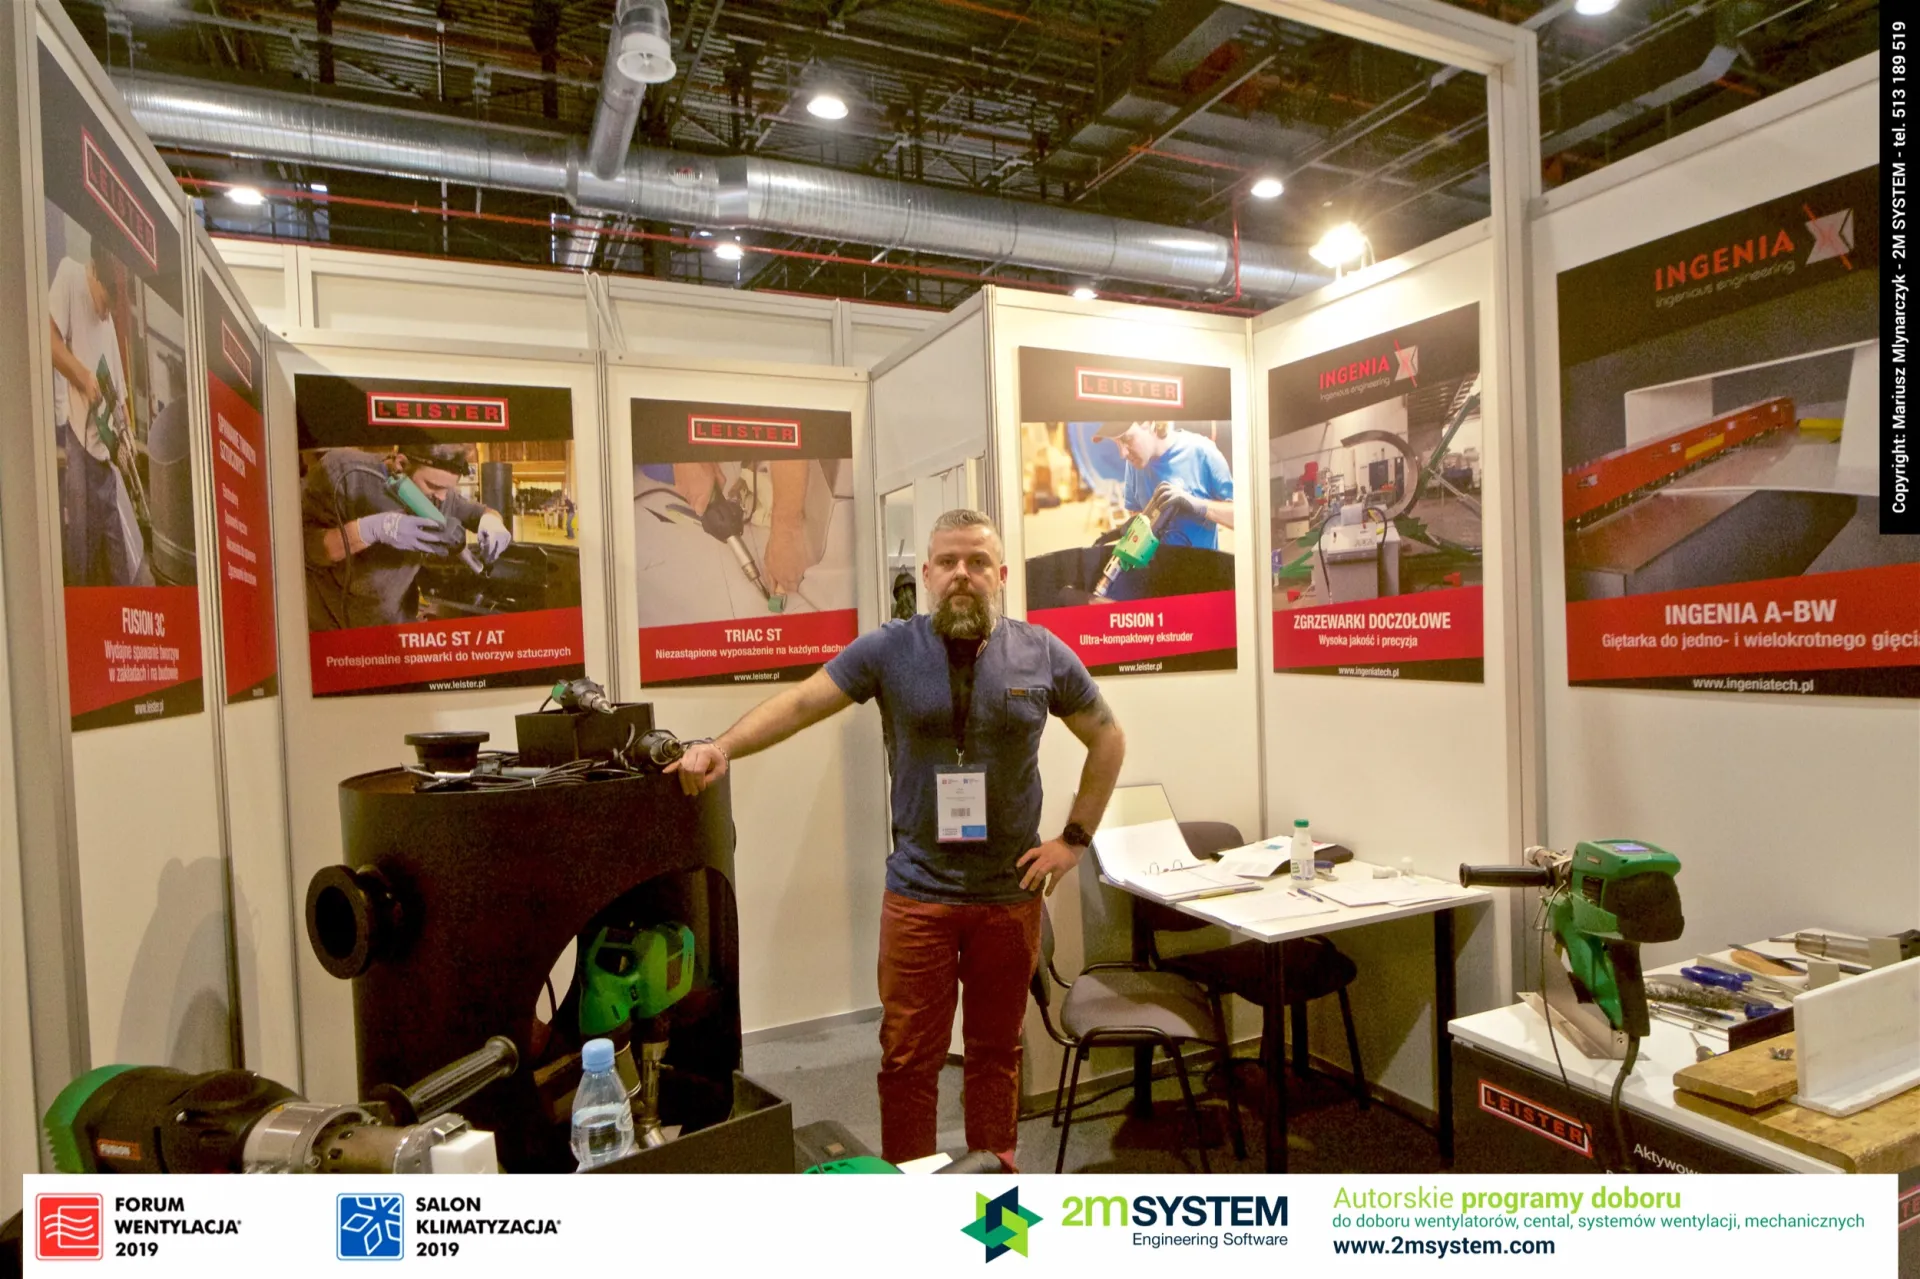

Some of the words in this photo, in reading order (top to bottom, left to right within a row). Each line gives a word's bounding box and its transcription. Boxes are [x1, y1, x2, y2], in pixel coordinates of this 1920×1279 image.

[88, 149, 153, 253] LEISTER
[1654, 228, 1795, 292] INGENIA
[1655, 282, 1714, 309] ingenious
[1715, 259, 1796, 291] engineering
[1319, 355, 1391, 390] INGENIA
[1084, 375, 1177, 399] LEISTER
[1320, 387, 1349, 402] ingenious
[1350, 376, 1391, 395] engineering
[377, 401, 500, 421] LEISTER
[696, 423, 793, 441] LEISTER
[122, 607, 153, 635] FUSION
[155, 612, 165, 637] 3C
[1109, 612, 1154, 629] FUSION
[1157, 612, 1164, 627] 1
[1293, 613, 1366, 630] ZGRZEWARKI
[1369, 612, 1451, 630] DOCZOŁOWE
[1664, 601, 1758, 626] INGENIA
[1763, 598, 1838, 624] A-BW
[398, 632, 447, 648] TRIAC
[451, 632, 471, 646] ST
[475, 631, 482, 645] /
[486, 630, 505, 645] AT
[724, 629, 764, 643] TRIAC
[766, 628, 783, 641] ST
[1079, 633, 1155, 646] Ultra-kompaktowy
[1156, 631, 1194, 643] ekstruder
[1318, 634, 1348, 647] Wysoka
[1348, 634, 1375, 648] jakość
[1381, 635, 1418, 649] precyzja
[1602, 632, 1657, 651] Giętarka
[1660, 632, 1679, 647] do
[1682, 632, 1730, 650] jedno-
[1734, 631, 1739, 647] i
[1743, 630, 1866, 651] wielokrotnego
[1871, 629, 1920, 652] gięci
[104, 640, 132, 663] Wydajne
[326, 652, 401, 668] Profesjonalne
[404, 651, 453, 666] spawarki
[455, 650, 469, 662] do
[471, 648, 514, 662] tworzyw
[517, 646, 572, 660] sztucznych
[655, 648, 718, 660] Niezastąpione
[719, 645, 774, 658] wyposażenie
[776, 647, 787, 655] na
[788, 643, 820, 656] każdym
[734, 671, 780, 682] www.leister.pl
[1119, 662, 1163, 673] www.leister.pl
[1338, 666, 1400, 679] www.ingeniatech.pl
[429, 680, 487, 692] www.leister.pl
[1692, 677, 1815, 693] www.ingeniatech.pl
[1486, 1088, 1584, 1144] LEISTER
[1633, 1143, 1702, 1174] Aktywow
